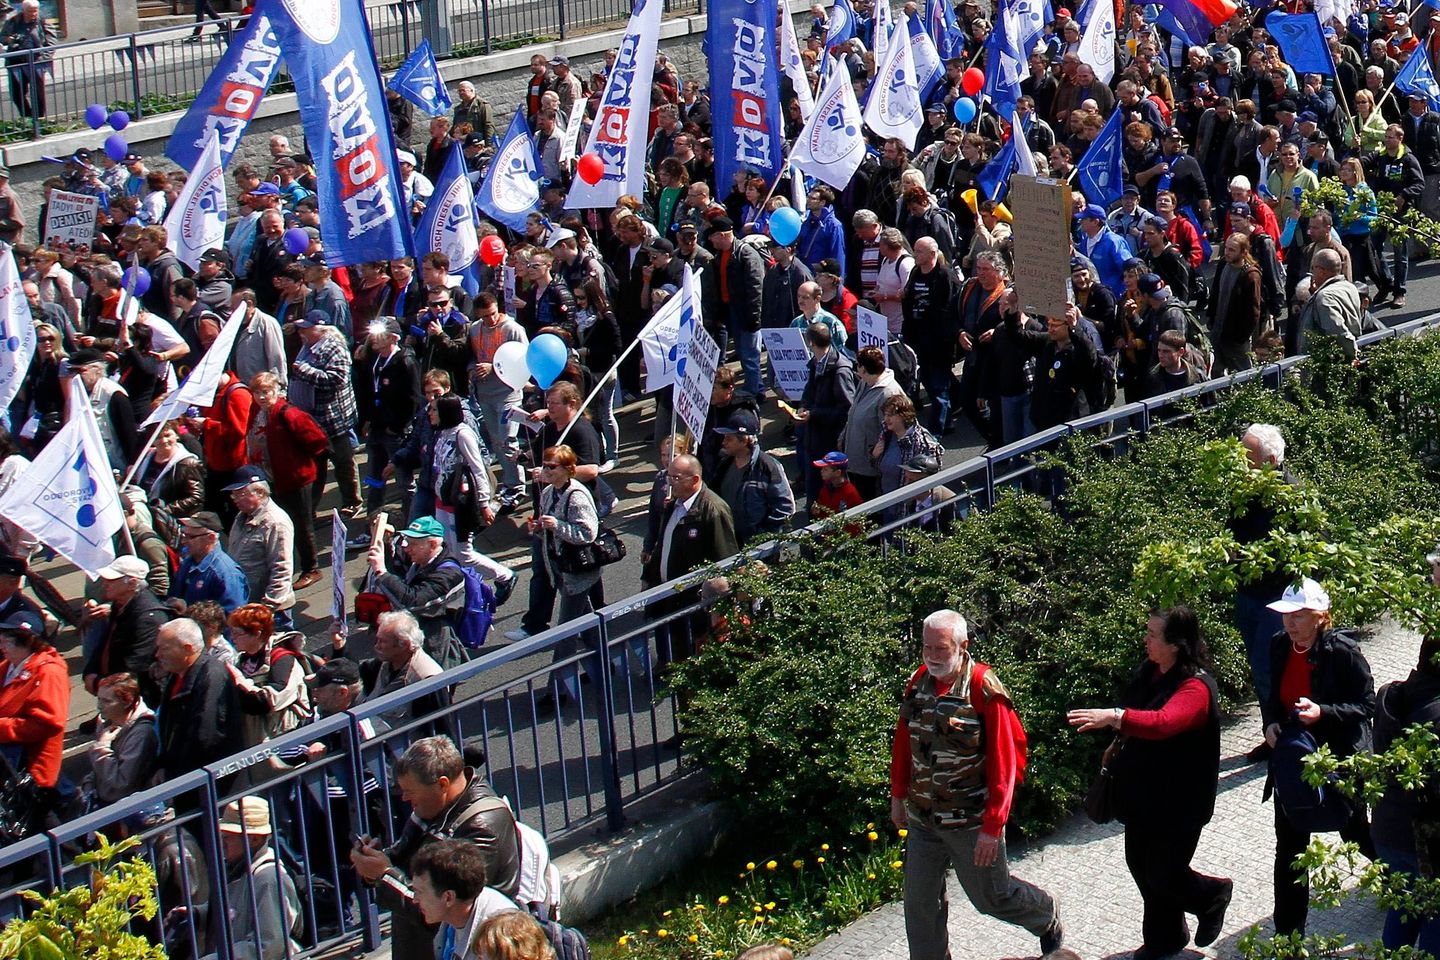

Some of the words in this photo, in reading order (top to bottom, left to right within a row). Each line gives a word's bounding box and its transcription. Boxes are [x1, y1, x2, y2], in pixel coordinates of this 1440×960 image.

[596, 33, 641, 183] KOVO
[732, 17, 774, 170] KOVO
[51, 210, 93, 229] DEMISI!
[860, 330, 885, 351] STOP
